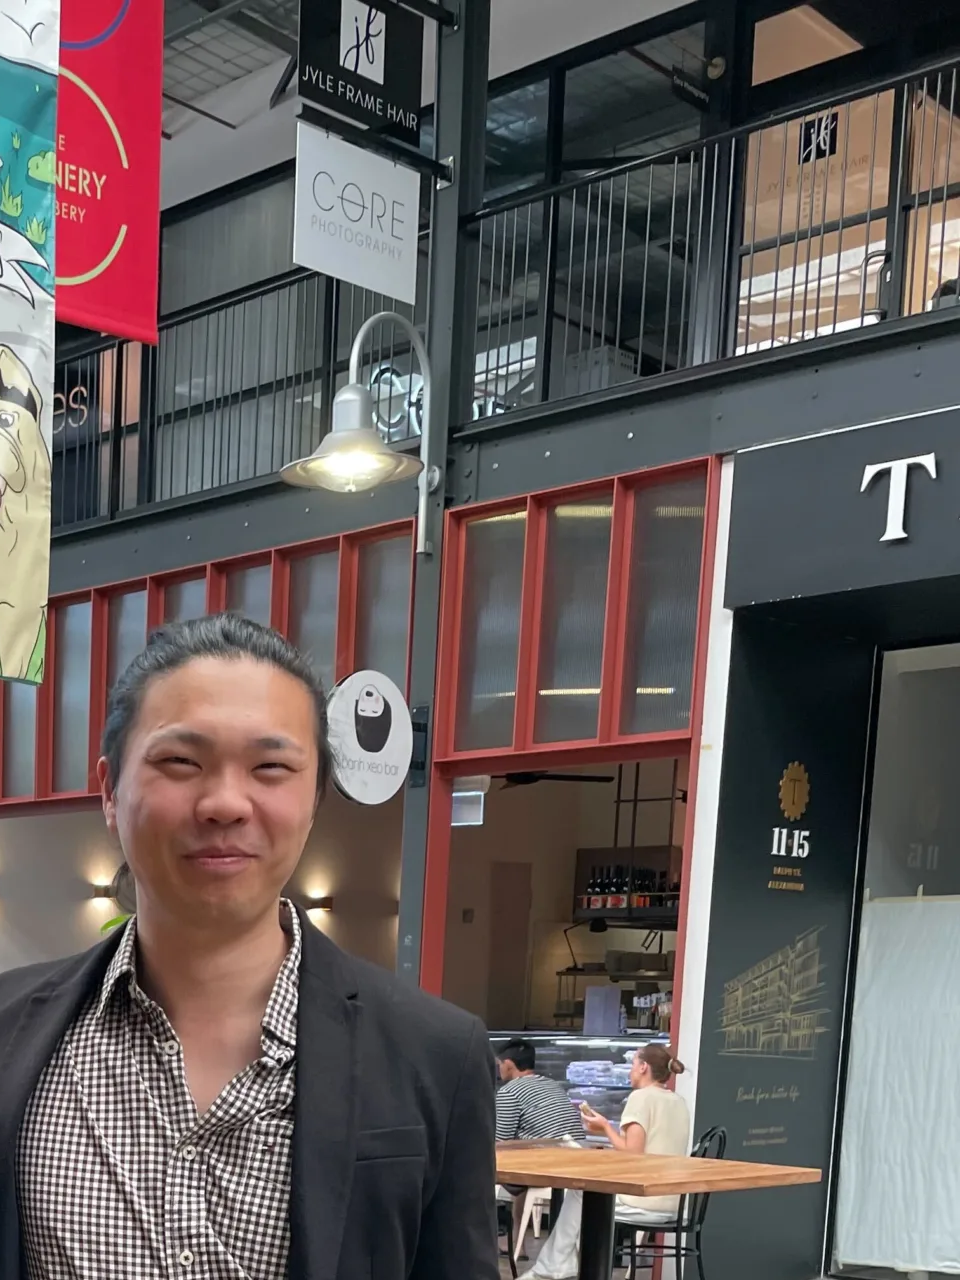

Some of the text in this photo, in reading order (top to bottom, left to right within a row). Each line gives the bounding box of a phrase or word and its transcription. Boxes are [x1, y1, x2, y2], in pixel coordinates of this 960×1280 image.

[302, 64, 418, 131] JYLE FRAME HAIR
[311, 214, 403, 260] PHOTOGRAPHY
[312, 171, 405, 241] CORE
[860, 452, 937, 542] T
